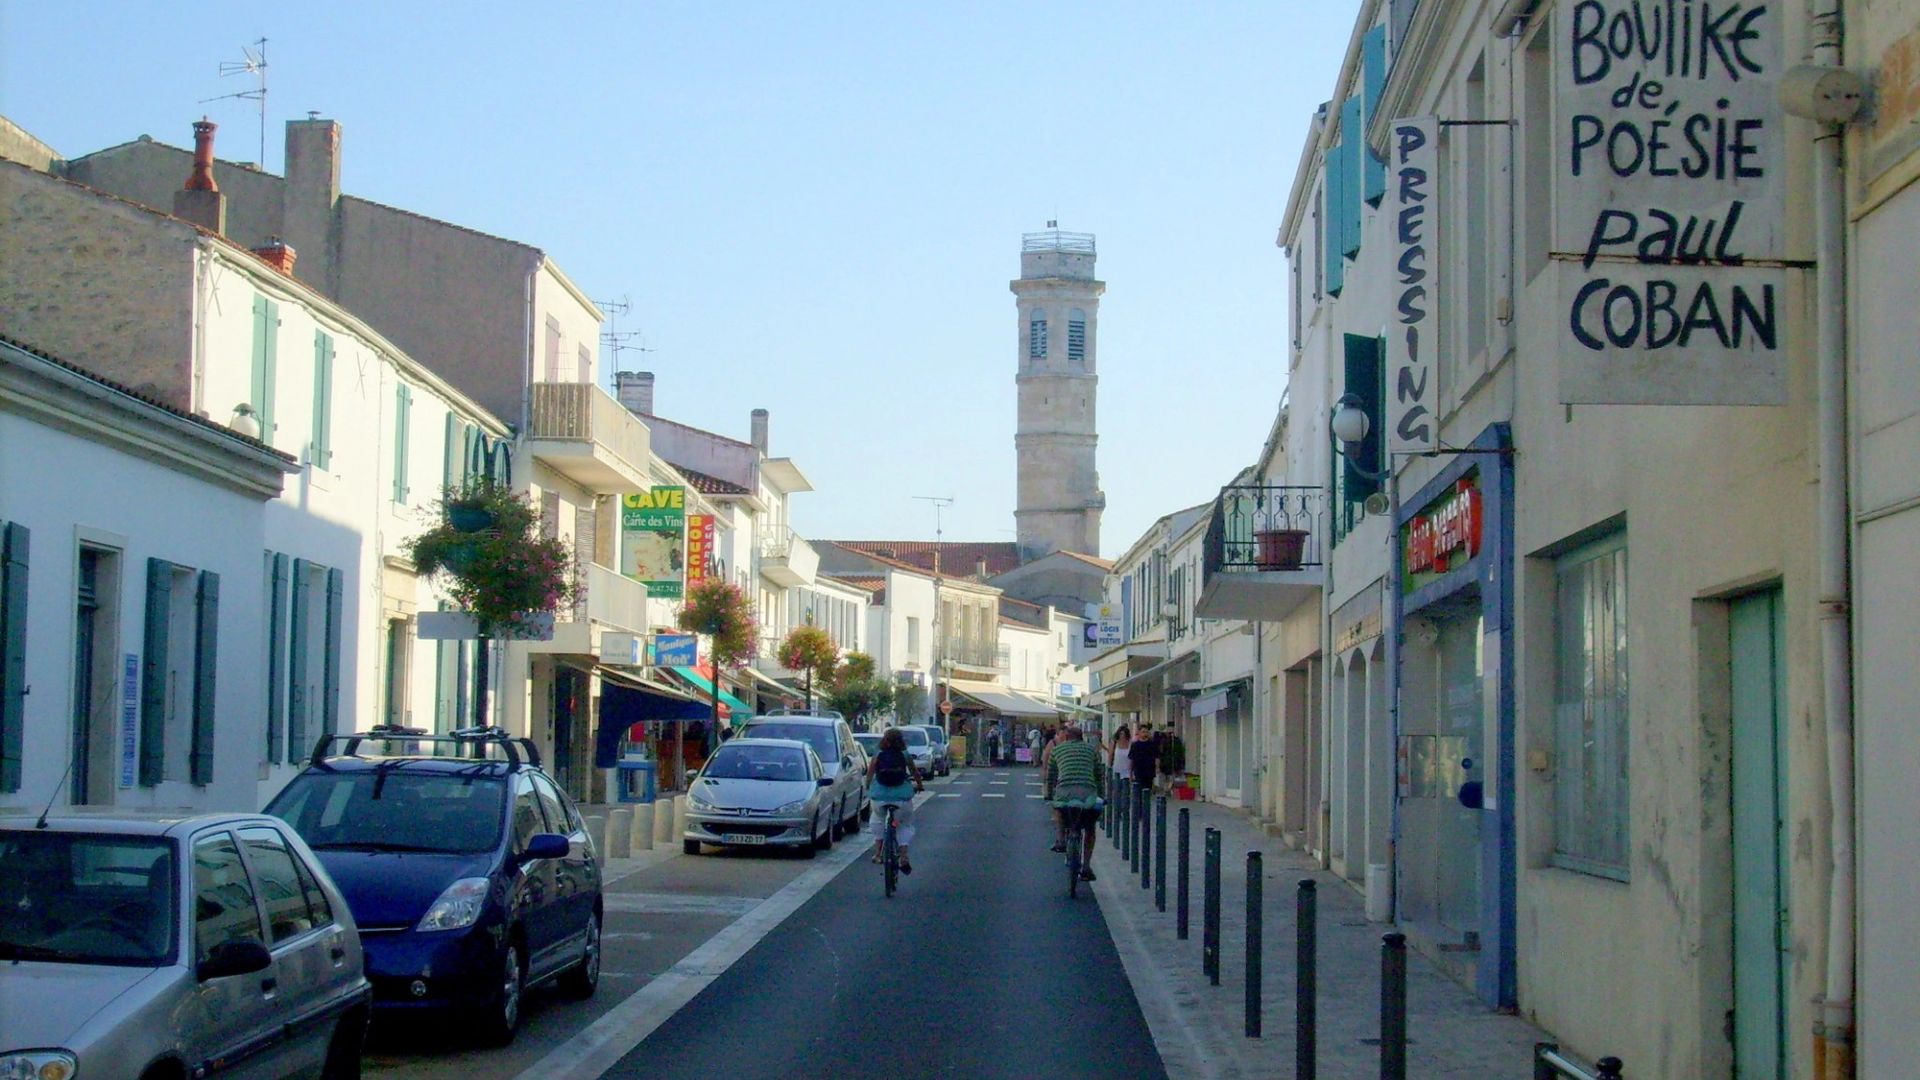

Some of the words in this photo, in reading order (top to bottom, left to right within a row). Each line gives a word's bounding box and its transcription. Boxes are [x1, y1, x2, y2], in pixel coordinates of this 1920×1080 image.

[1611, 71, 1663, 109] de
[1396, 125, 1428, 443] PRESSING
[1570, 278, 1777, 351] COBAN
[624, 489, 684, 509] CAVE
[623, 514, 647, 527] Carte
[647, 515, 662, 527] des
[664, 515, 683, 527] Vins
